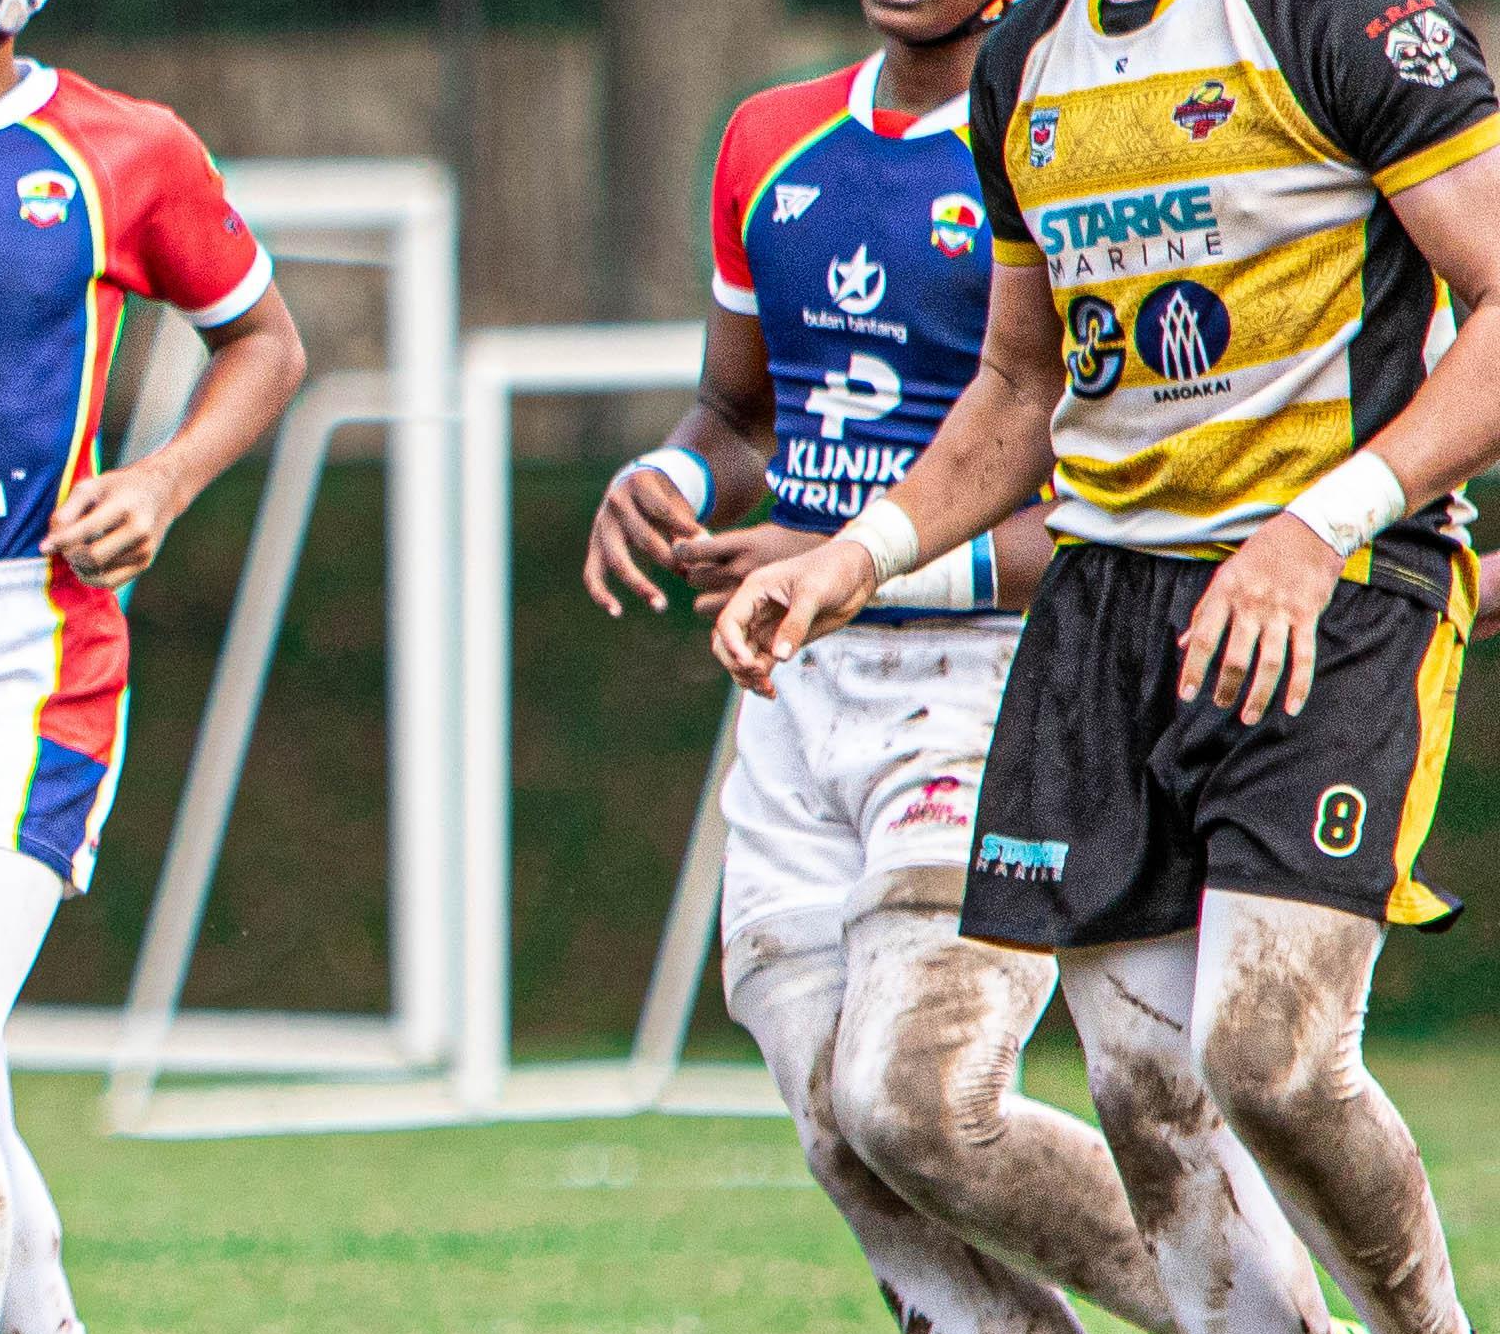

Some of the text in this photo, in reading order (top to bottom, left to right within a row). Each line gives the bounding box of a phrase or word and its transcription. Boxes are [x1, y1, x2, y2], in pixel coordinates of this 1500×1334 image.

[1041, 185, 1218, 256] STARKE
[1049, 231, 1224, 282] MARINE
[787, 438, 915, 482] KLINIK
[1314, 785, 1367, 858] 8
